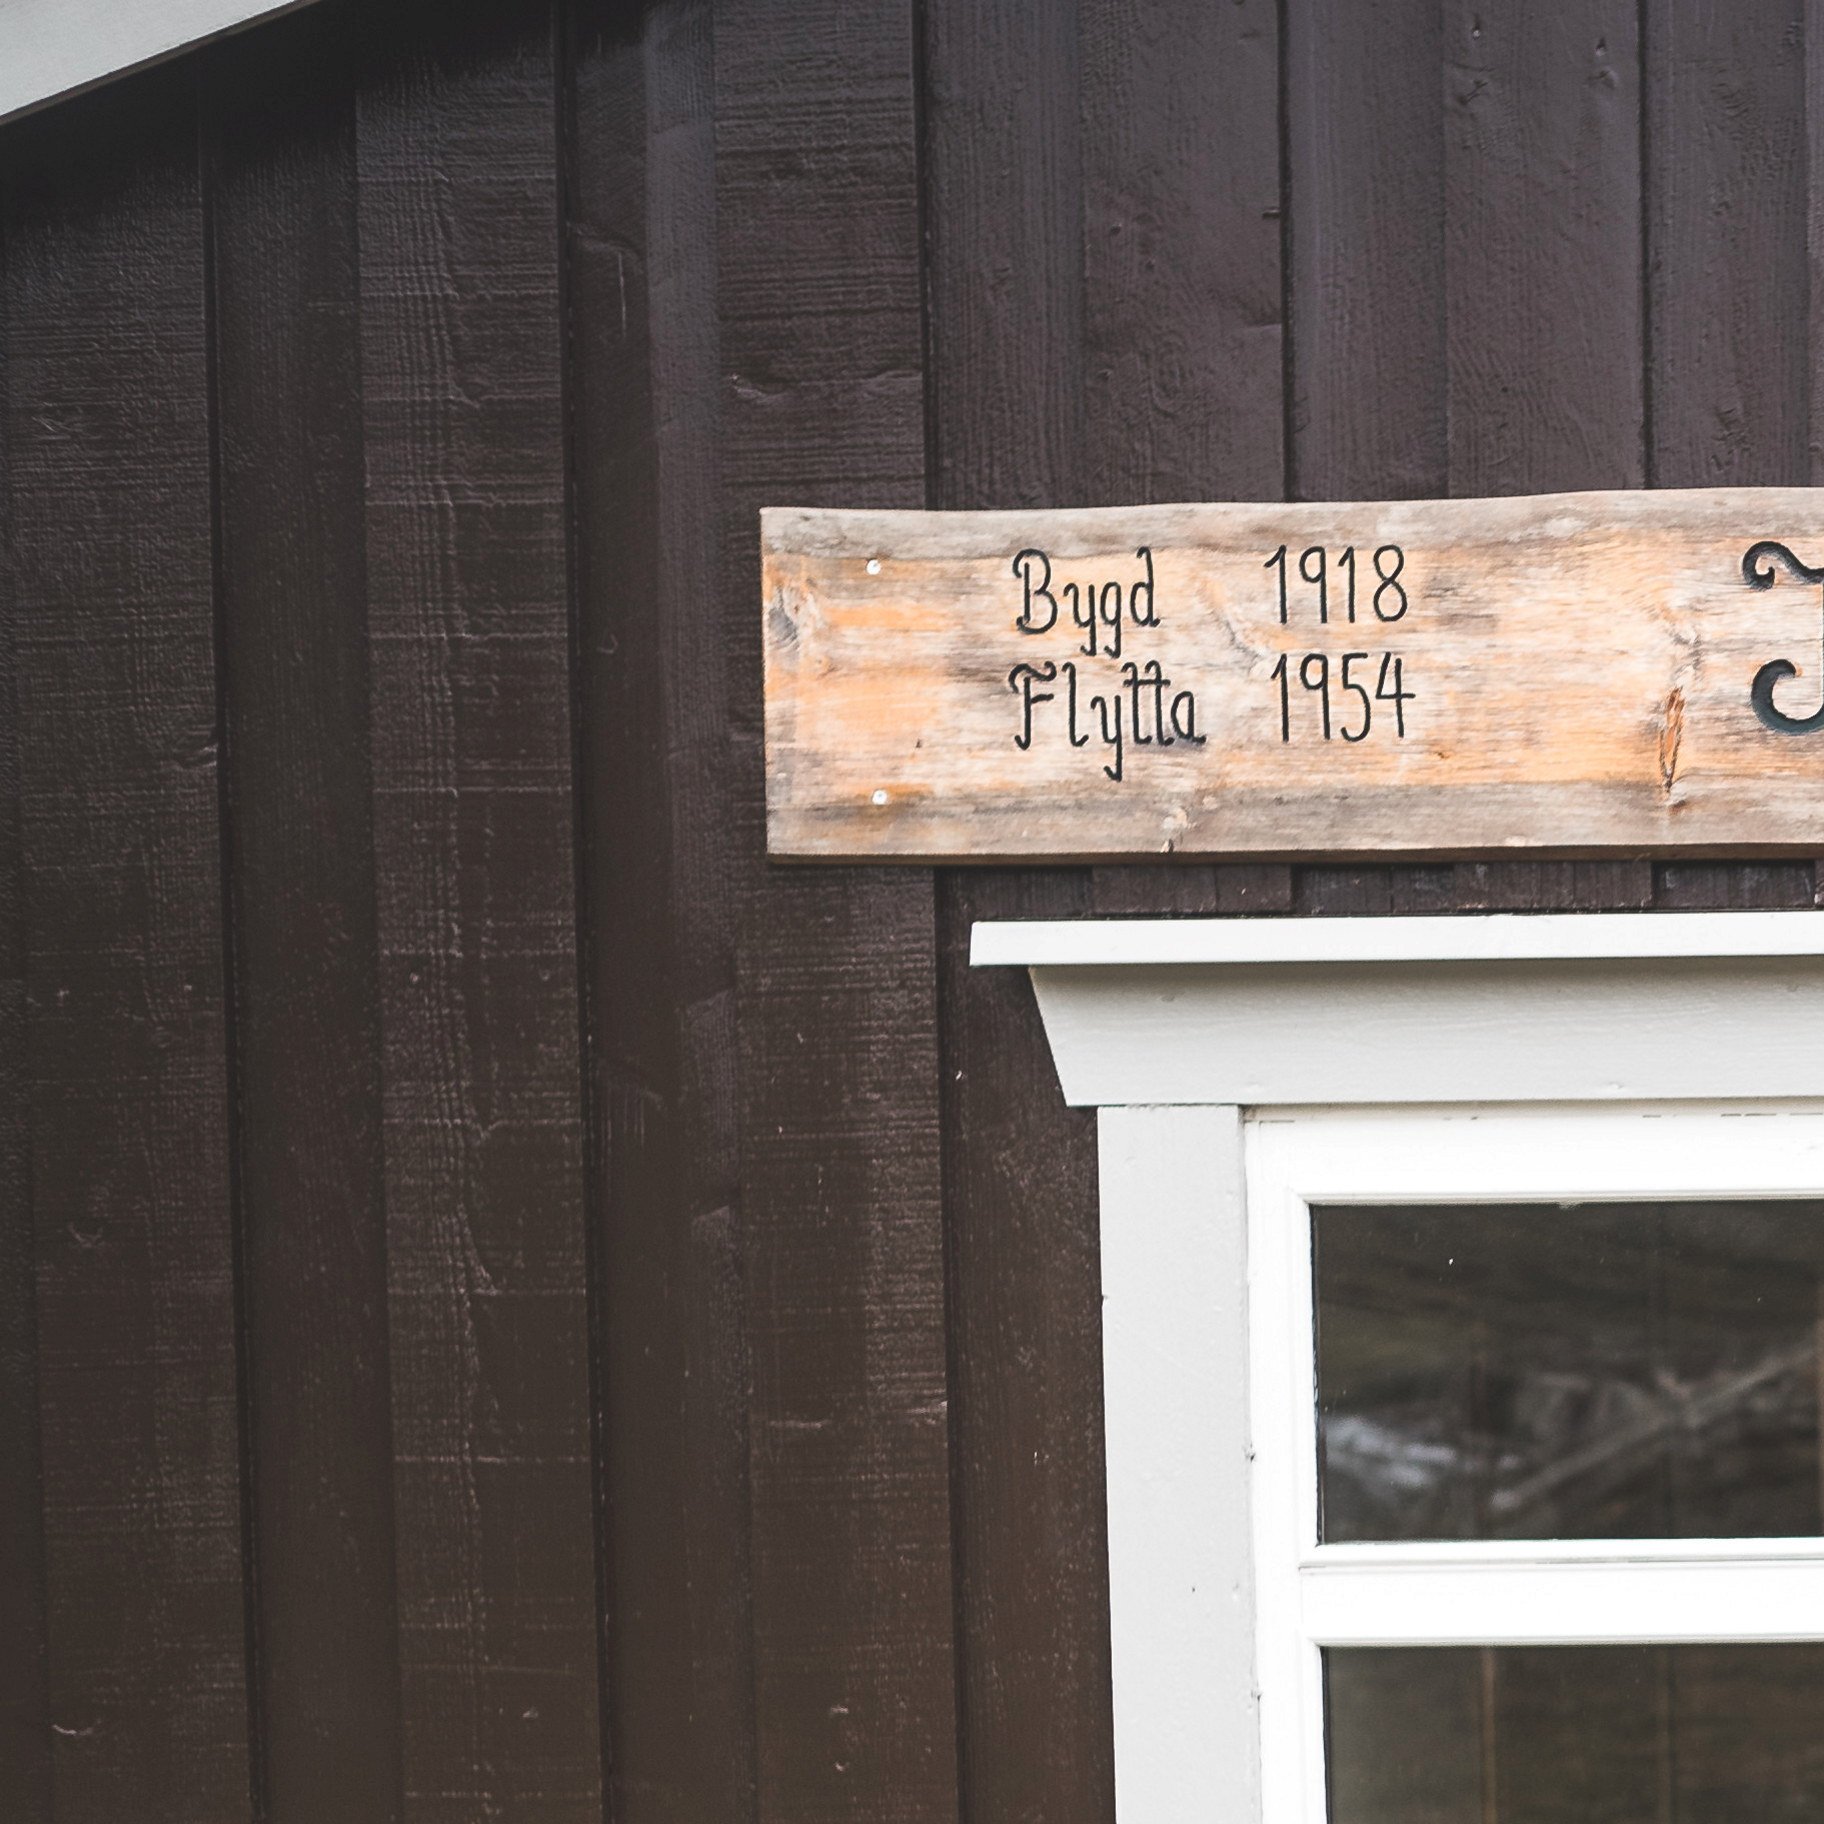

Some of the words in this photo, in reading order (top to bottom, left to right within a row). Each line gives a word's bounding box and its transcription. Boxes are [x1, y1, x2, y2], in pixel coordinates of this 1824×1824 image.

[1011, 545, 1162, 660] Bygd
[1263, 543, 1409, 626] 1918
[1007, 659, 1208, 783] Flytta
[1269, 650, 1417, 744] 1954
